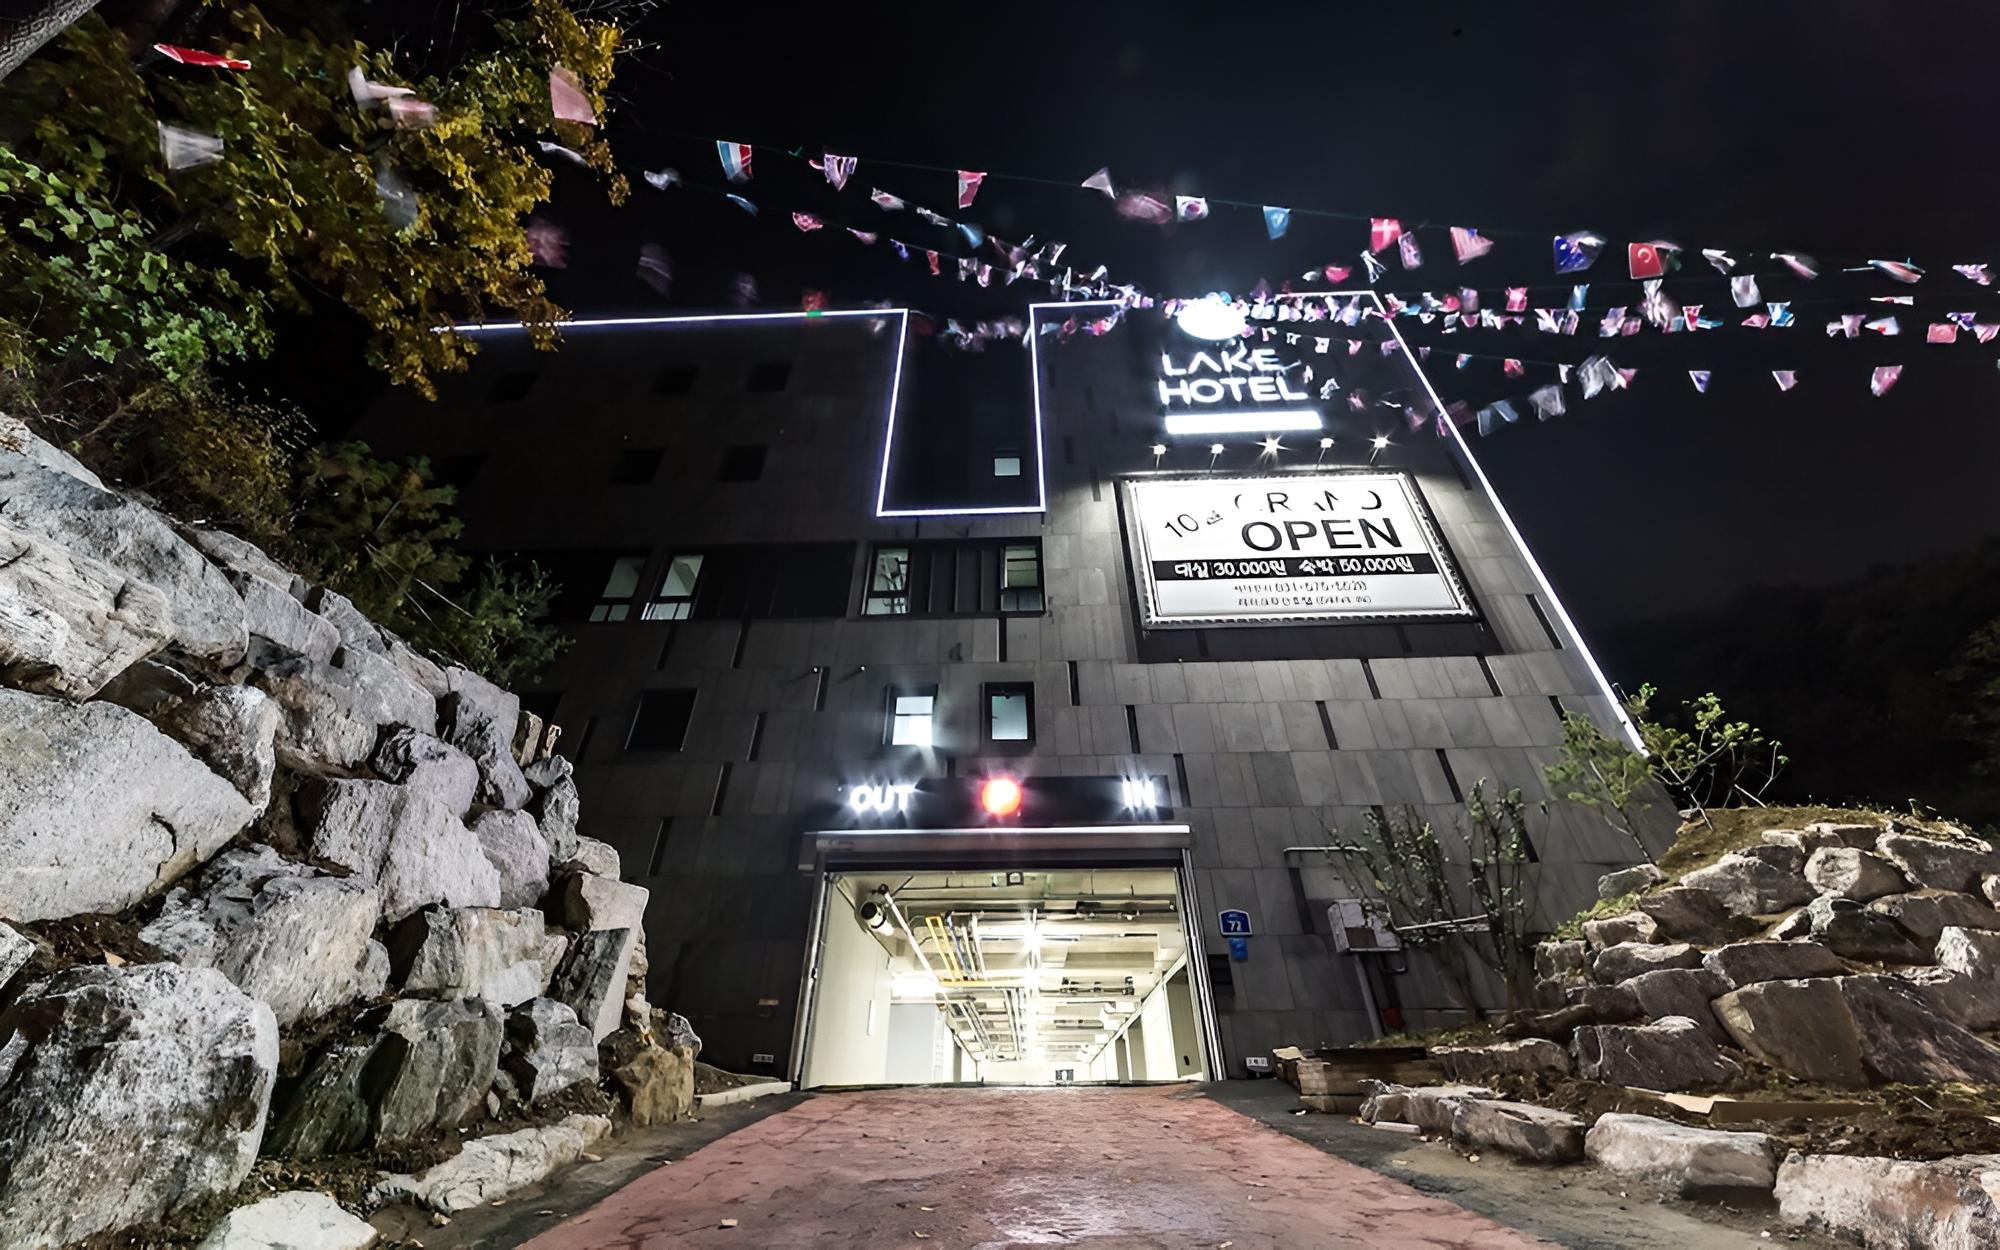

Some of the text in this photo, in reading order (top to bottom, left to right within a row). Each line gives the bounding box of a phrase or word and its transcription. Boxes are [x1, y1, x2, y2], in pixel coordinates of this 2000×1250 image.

[1161, 346, 1281, 377] LAKE
[1158, 375, 1309, 406] HOTEL
[1234, 490, 1383, 513] RND
[1241, 517, 1403, 552] OPEN
[848, 783, 917, 813] OUT
[1121, 776, 1157, 809] IN
